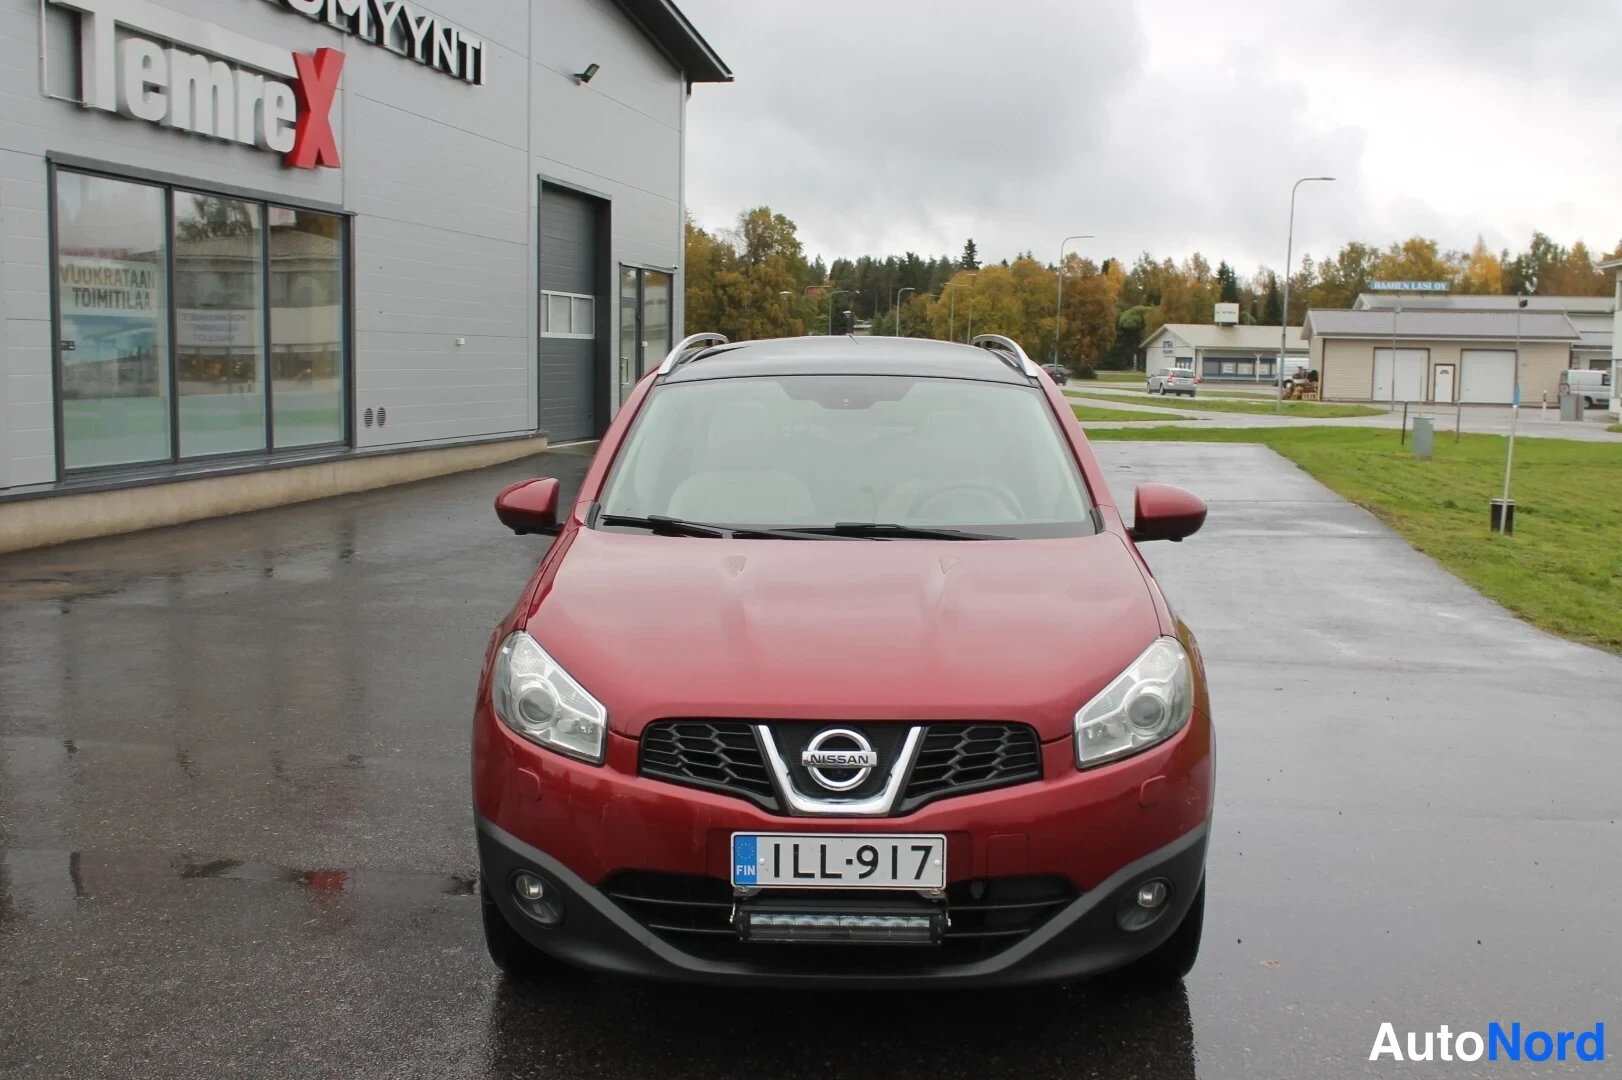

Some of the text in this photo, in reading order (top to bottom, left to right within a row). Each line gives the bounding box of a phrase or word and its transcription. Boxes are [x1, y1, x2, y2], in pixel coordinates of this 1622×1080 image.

[284, 0, 486, 86] MYYNTI
[44, 0, 346, 169] TemreX
[72, 287, 152, 310] TOIMITILAA
[810, 753, 869, 765] NISSAN
[736, 865, 756, 876] FIN
[773, 843, 933, 880] ILL-917
